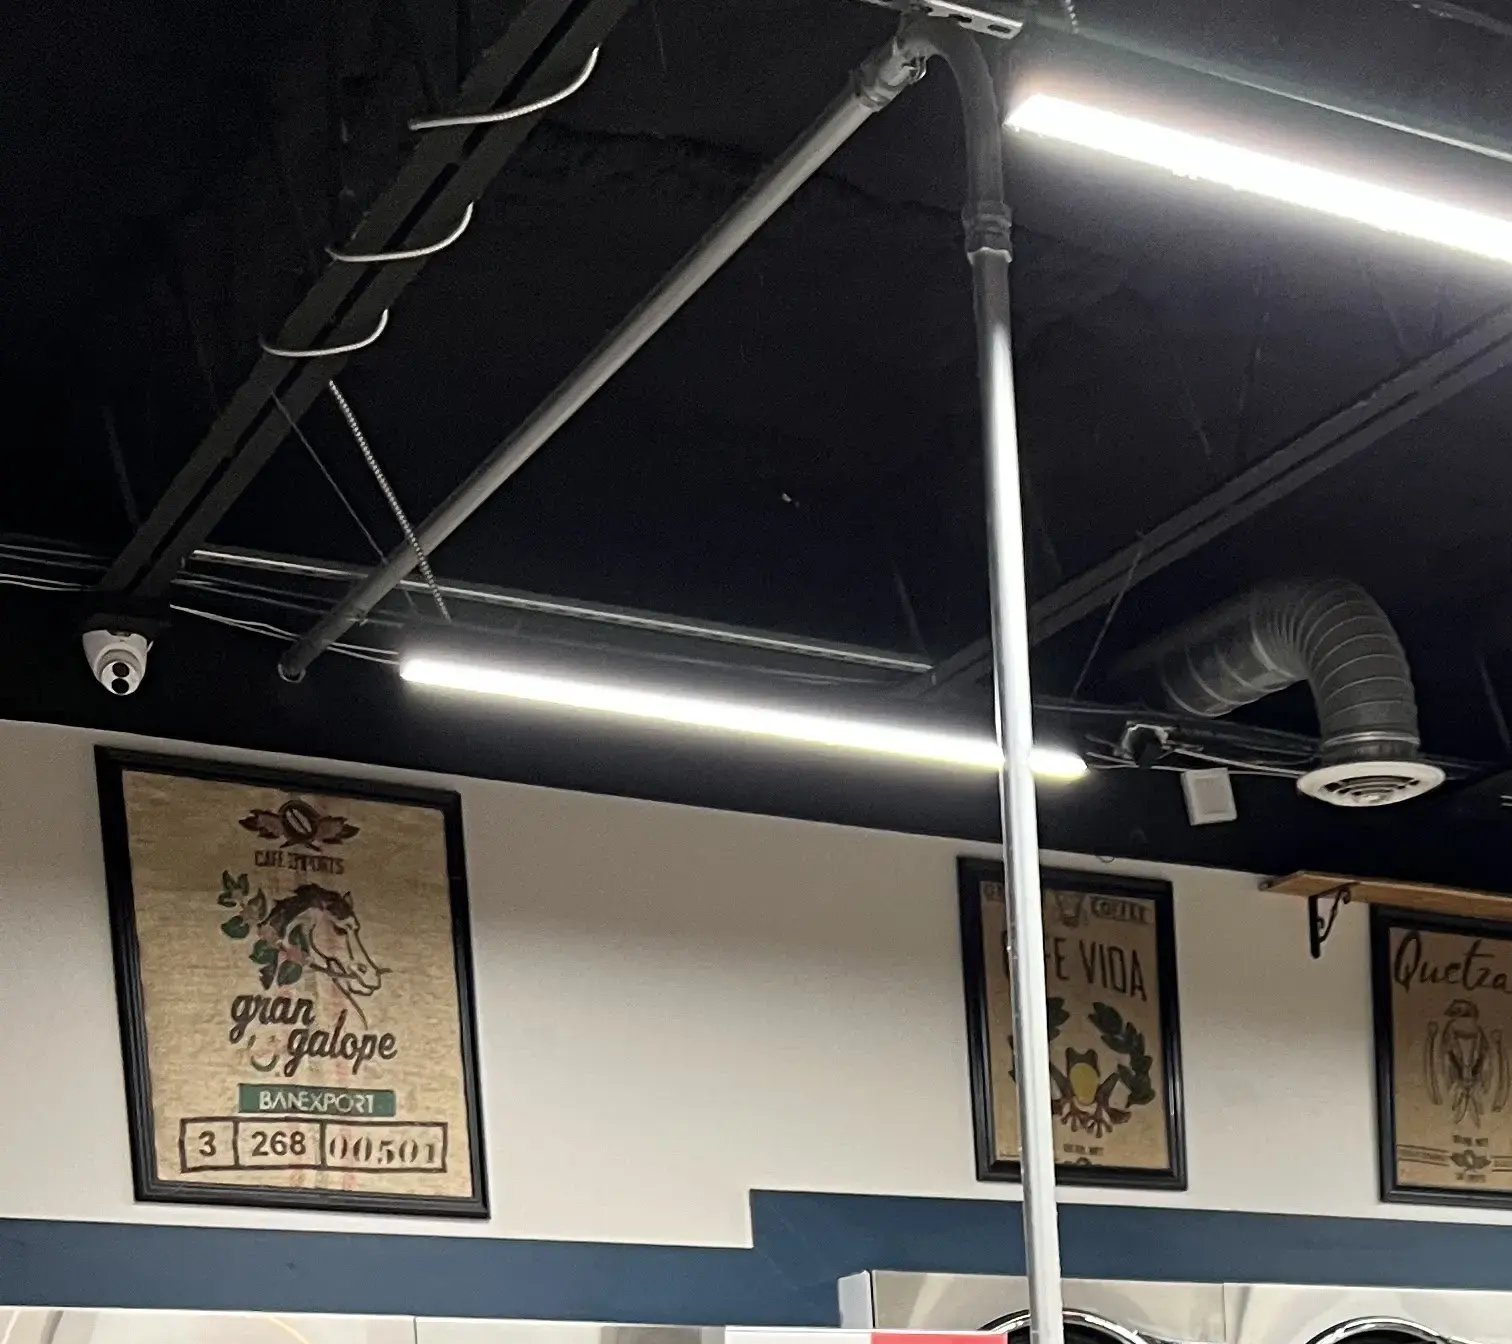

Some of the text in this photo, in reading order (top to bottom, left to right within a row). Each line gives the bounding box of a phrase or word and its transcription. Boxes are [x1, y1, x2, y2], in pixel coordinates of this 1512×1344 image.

[1078, 939, 1147, 1001] VIDA
[229, 993, 315, 1043] gran
[283, 1008, 398, 1077] galope
[258, 1089, 375, 1115] BANEXPORT
[198, 1131, 217, 1157] 3
[250, 1131, 307, 1157] 268
